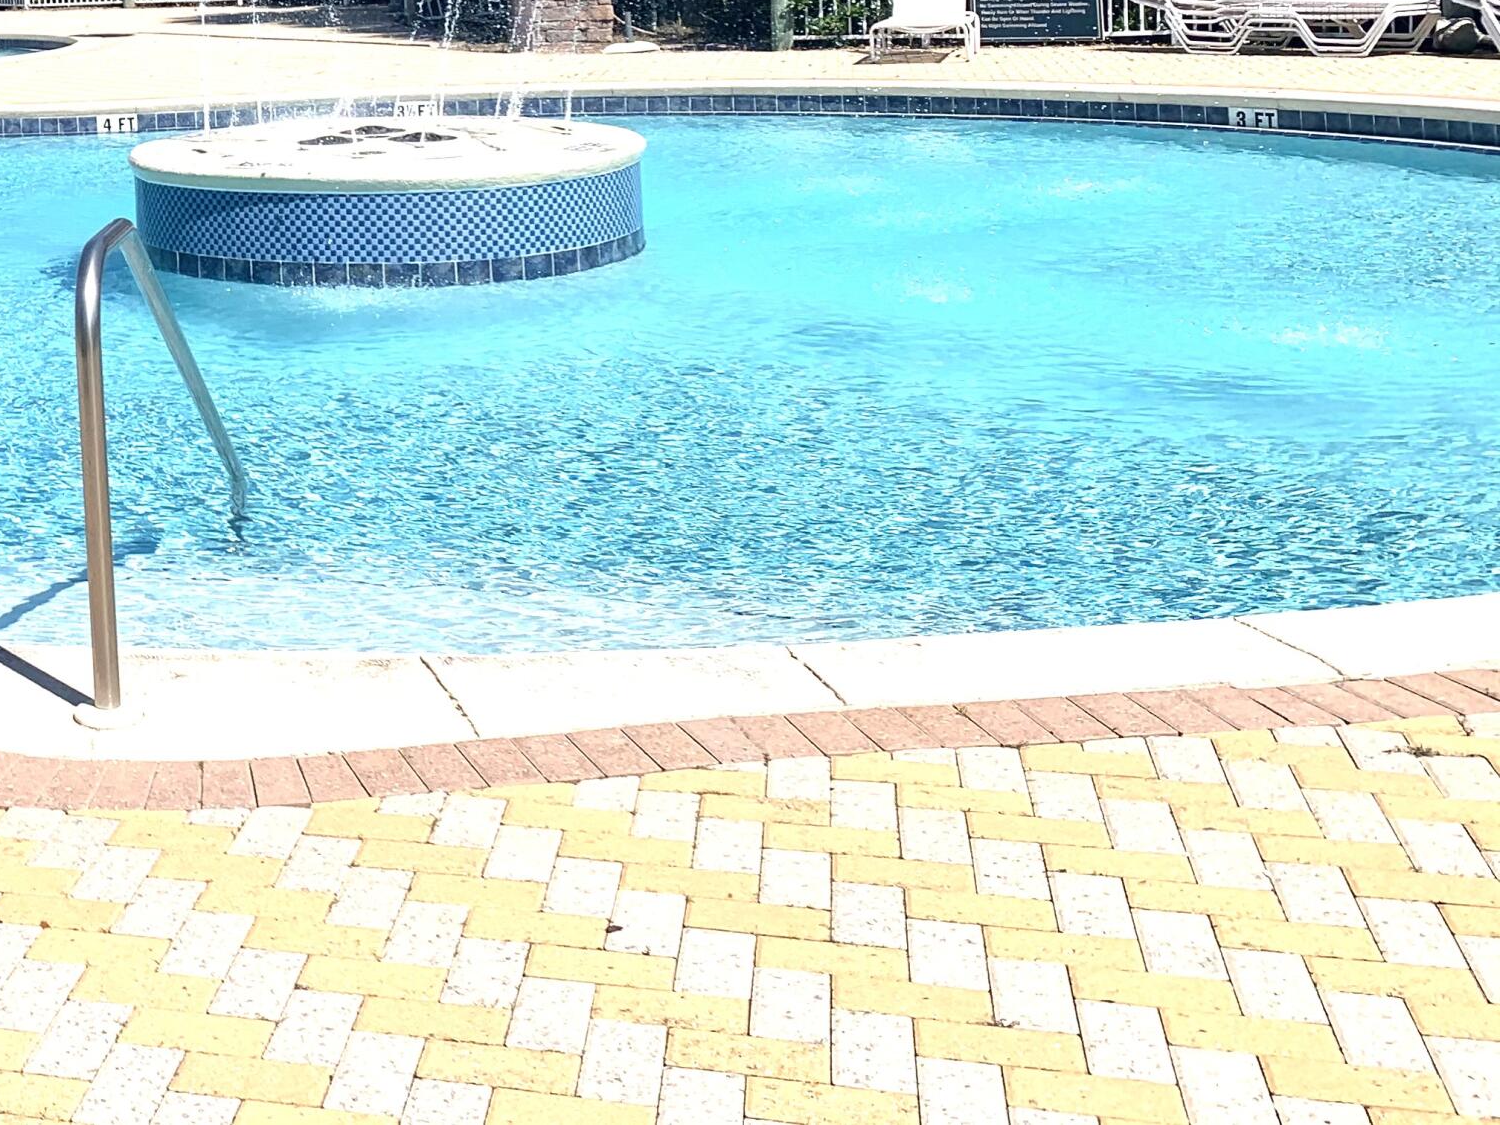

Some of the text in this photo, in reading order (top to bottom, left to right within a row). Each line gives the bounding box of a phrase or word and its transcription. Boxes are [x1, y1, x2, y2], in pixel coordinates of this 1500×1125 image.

[103, 117, 135, 131] 4 FT
[1236, 110, 1275, 128] 3 FT
